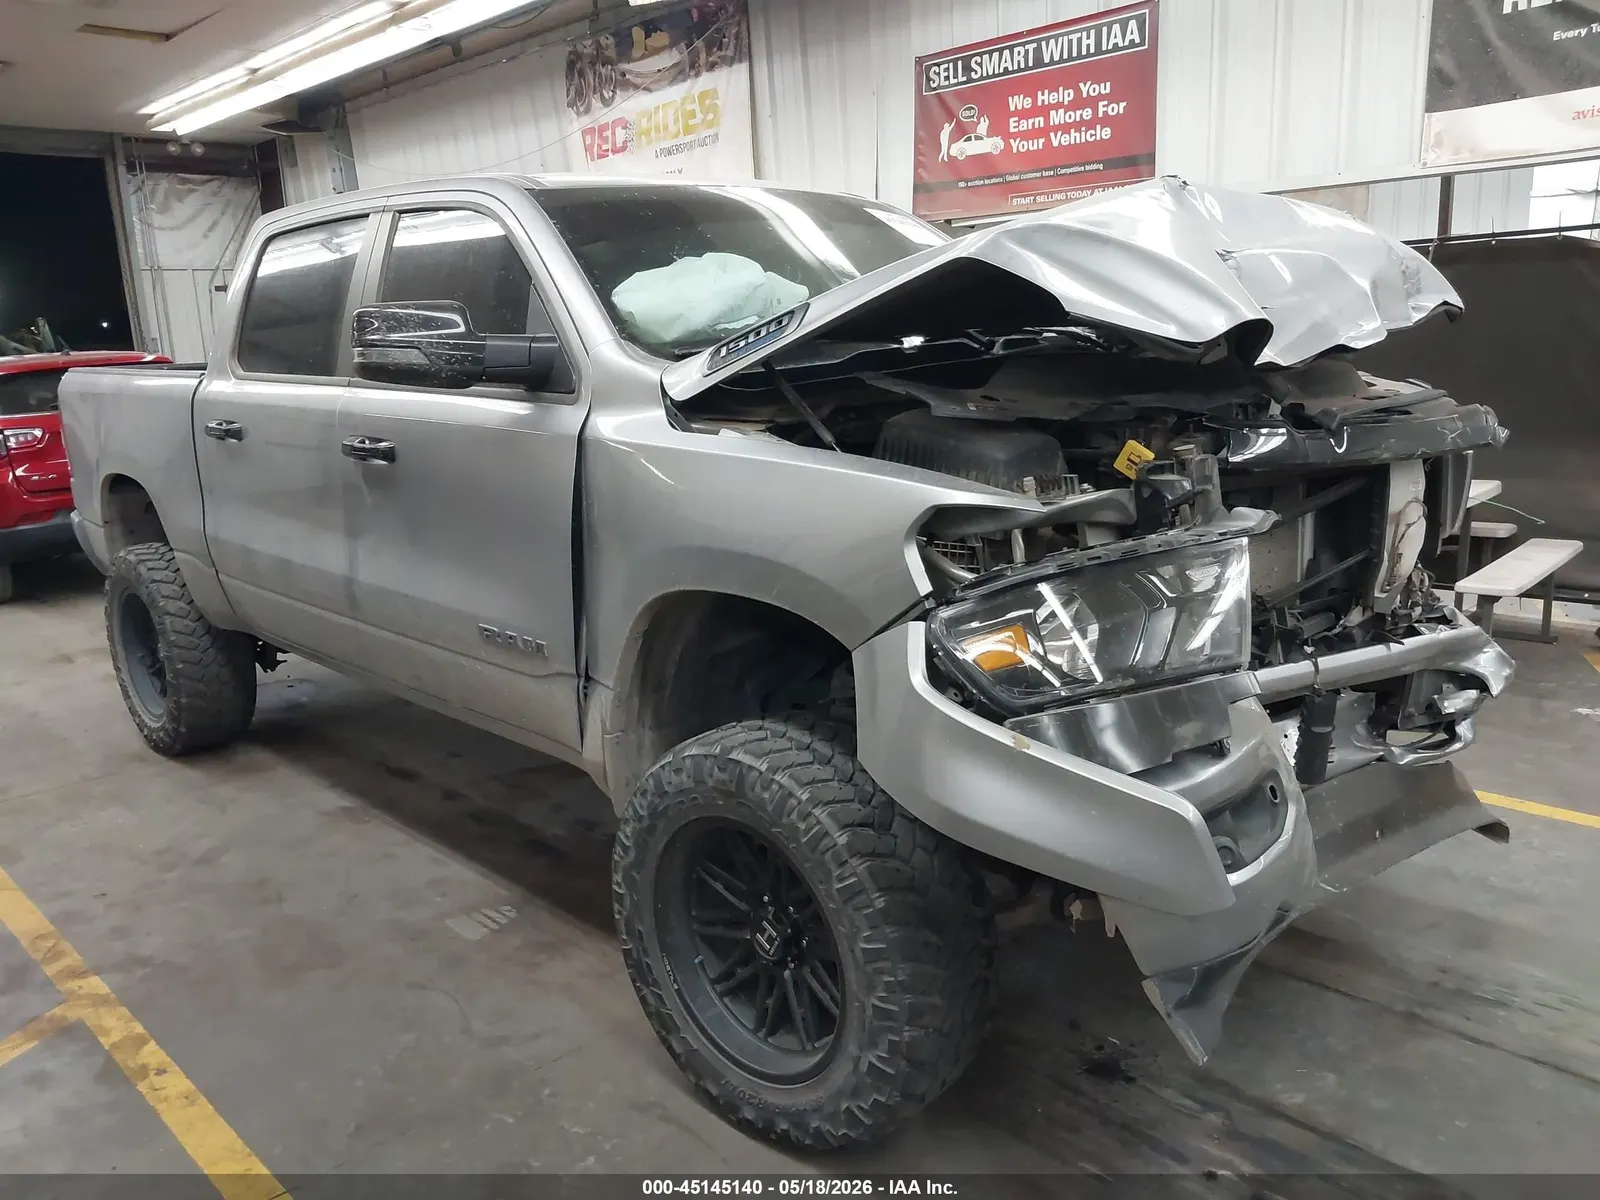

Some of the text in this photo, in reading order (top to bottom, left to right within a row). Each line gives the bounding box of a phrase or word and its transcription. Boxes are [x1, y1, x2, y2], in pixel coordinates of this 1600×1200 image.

[1552, 27, 1589, 41] Every
[928, 19, 1141, 88] SELL SMART WITH IAA
[1008, 80, 1111, 112] We Help You
[1009, 100, 1127, 133] Earn More For
[581, 116, 628, 163] REC
[1009, 124, 1112, 154] Your Vehicle
[1005, 174, 1021, 182] Global
[1020, 171, 1043, 180] customer
[1042, 169, 1055, 177] base
[1056, 163, 1085, 175] Competitive
[1085, 162, 1104, 172] bidding
[1012, 195, 1035, 206] START
[1035, 190, 1066, 203] SELLING
[1067, 188, 1093, 200] TODAY
[719, 313, 790, 358] 1500
[478, 622, 550, 660] RAM
